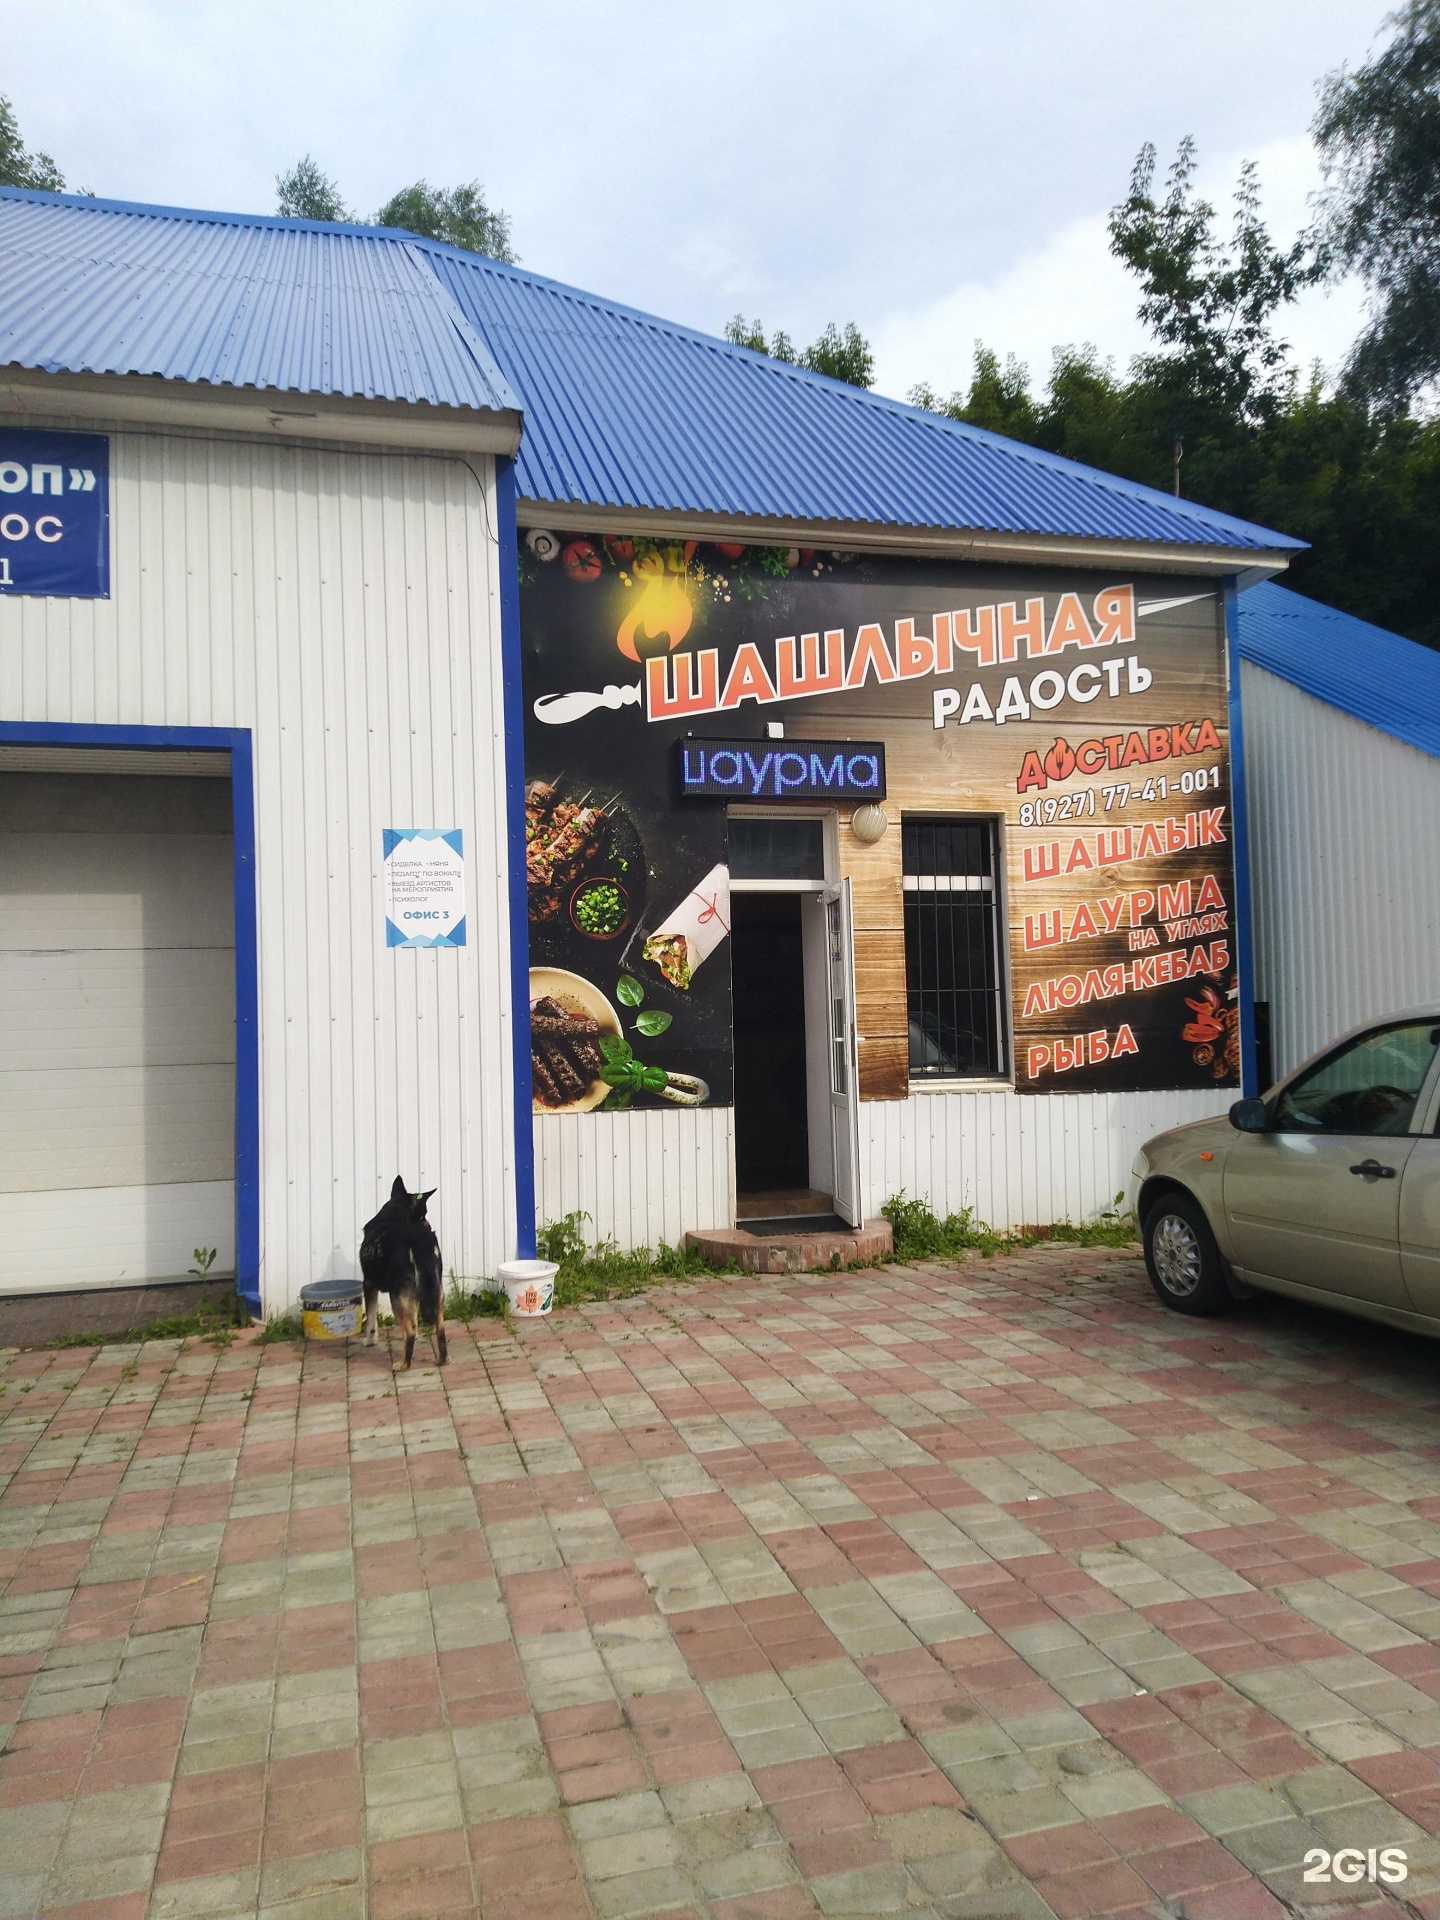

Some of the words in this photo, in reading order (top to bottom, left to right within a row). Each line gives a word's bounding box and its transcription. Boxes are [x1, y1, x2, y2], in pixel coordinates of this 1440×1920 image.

[646, 583, 1136, 722] ШАШЛЫЧНАЯ
[932, 655, 1154, 730] РАДОСТЬ
[1016, 717, 1223, 794] ДОСТАВКА
[1019, 788, 1095, 827] 8(927)
[1101, 765, 1220, 811] 77-41-001
[1023, 806, 1227, 883] ШАШЛЫК
[403, 911, 440, 920] ОФИС
[443, 911, 450, 919] 3
[1024, 874, 1226, 952] ШАУРМА
[1128, 928, 1159, 951] НА
[1165, 910, 1229, 942] УГЛЯХ
[1022, 939, 1230, 1018] ЛЮЛЯ-КЕБАБ
[1028, 1024, 1139, 1079] РЫБА
